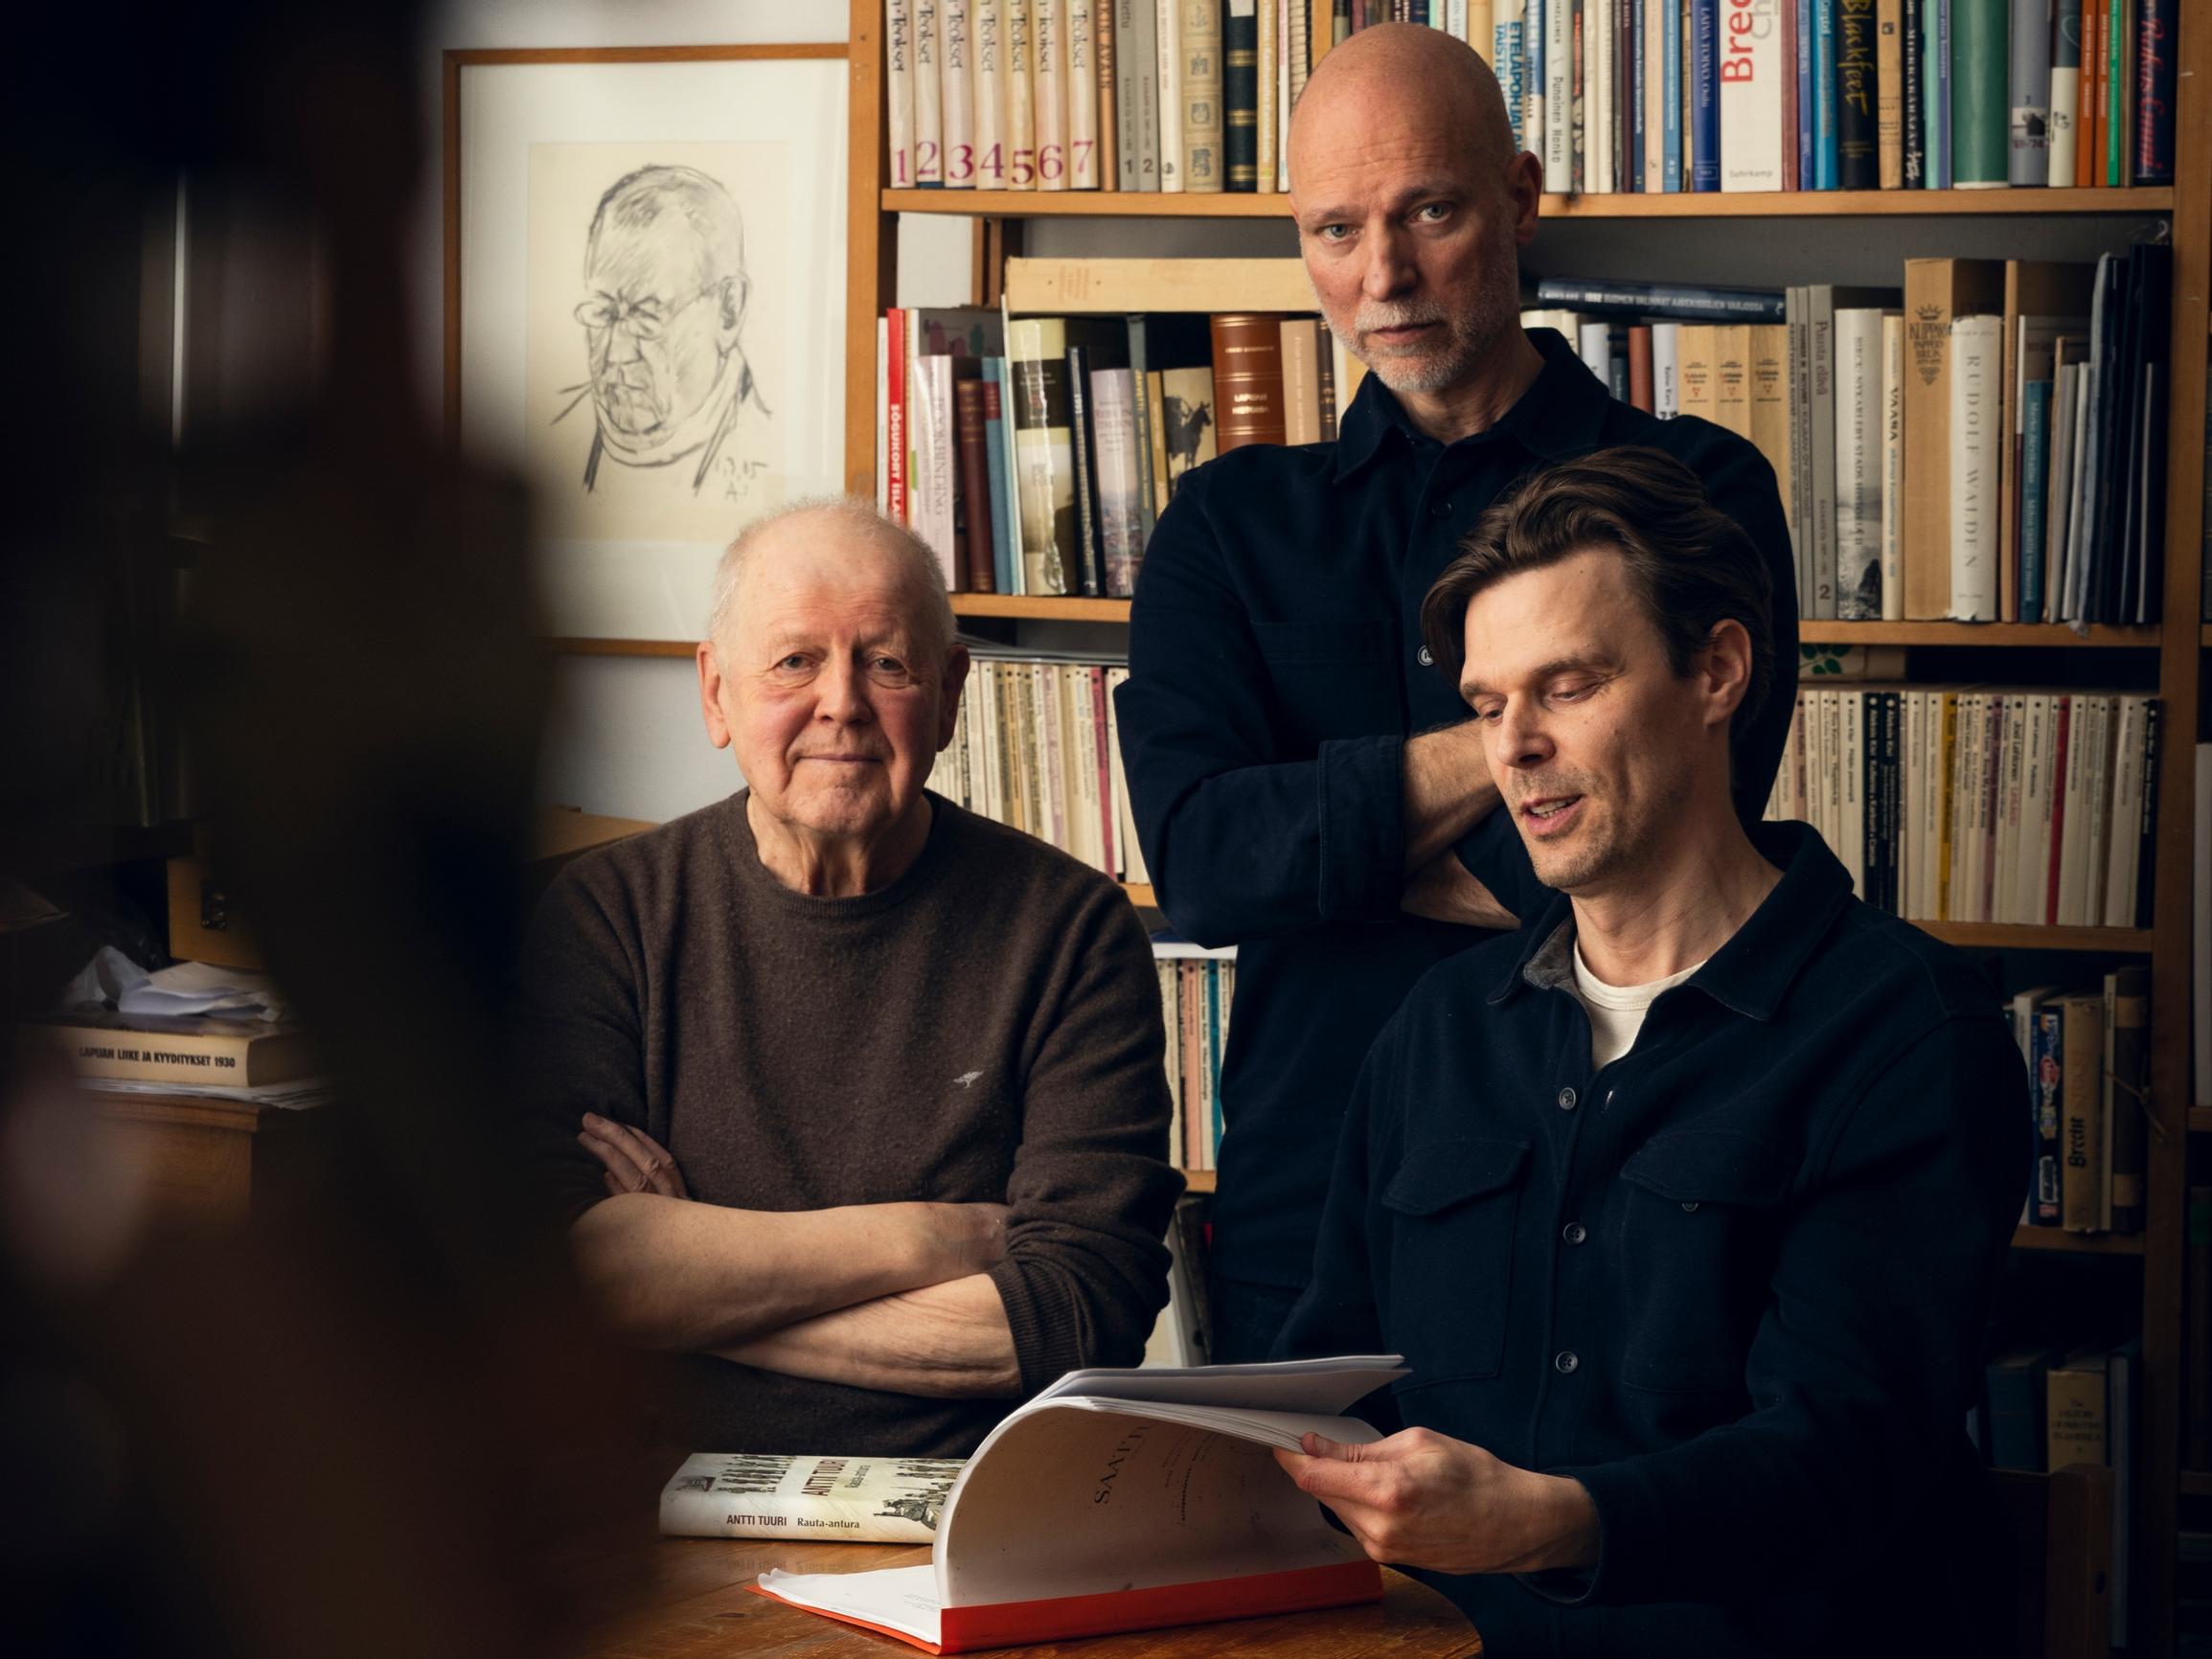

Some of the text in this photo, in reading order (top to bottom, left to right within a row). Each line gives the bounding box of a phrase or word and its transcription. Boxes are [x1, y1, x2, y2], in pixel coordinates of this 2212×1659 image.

[891, 12, 907, 184] Teokset 1
[916, 8, 939, 176] Teokset 2
[947, 11, 974, 180] Teokset 3
[979, 13, 1006, 180] Teokset 4
[1010, 13, 1035, 185] Teokset 5
[1038, 13, 1064, 181] Teokset 6
[1072, 10, 1094, 174] Teokset 7
[1124, 159, 1134, 173] 1
[1143, 159, 1153, 174] 2
[890, 403, 903, 479] SÖGUKORT
[933, 398, 946, 516] BOOKBINDING
[1962, 355, 1982, 570] RUDOLF WALDEN
[1819, 584, 1831, 601] 2
[117, 1048, 140, 1062] LIIKE
[142, 1050, 151, 1062] JA
[153, 1052, 211, 1067] KYYDITYKSET
[214, 1057, 236, 1068] 1930
[2067, 1117, 2087, 1169] Brecht
[726, 1514, 861, 1530] ANTTI TUURI Rauta-antura
[801, 1459, 850, 1496] ANTTI TUURI
